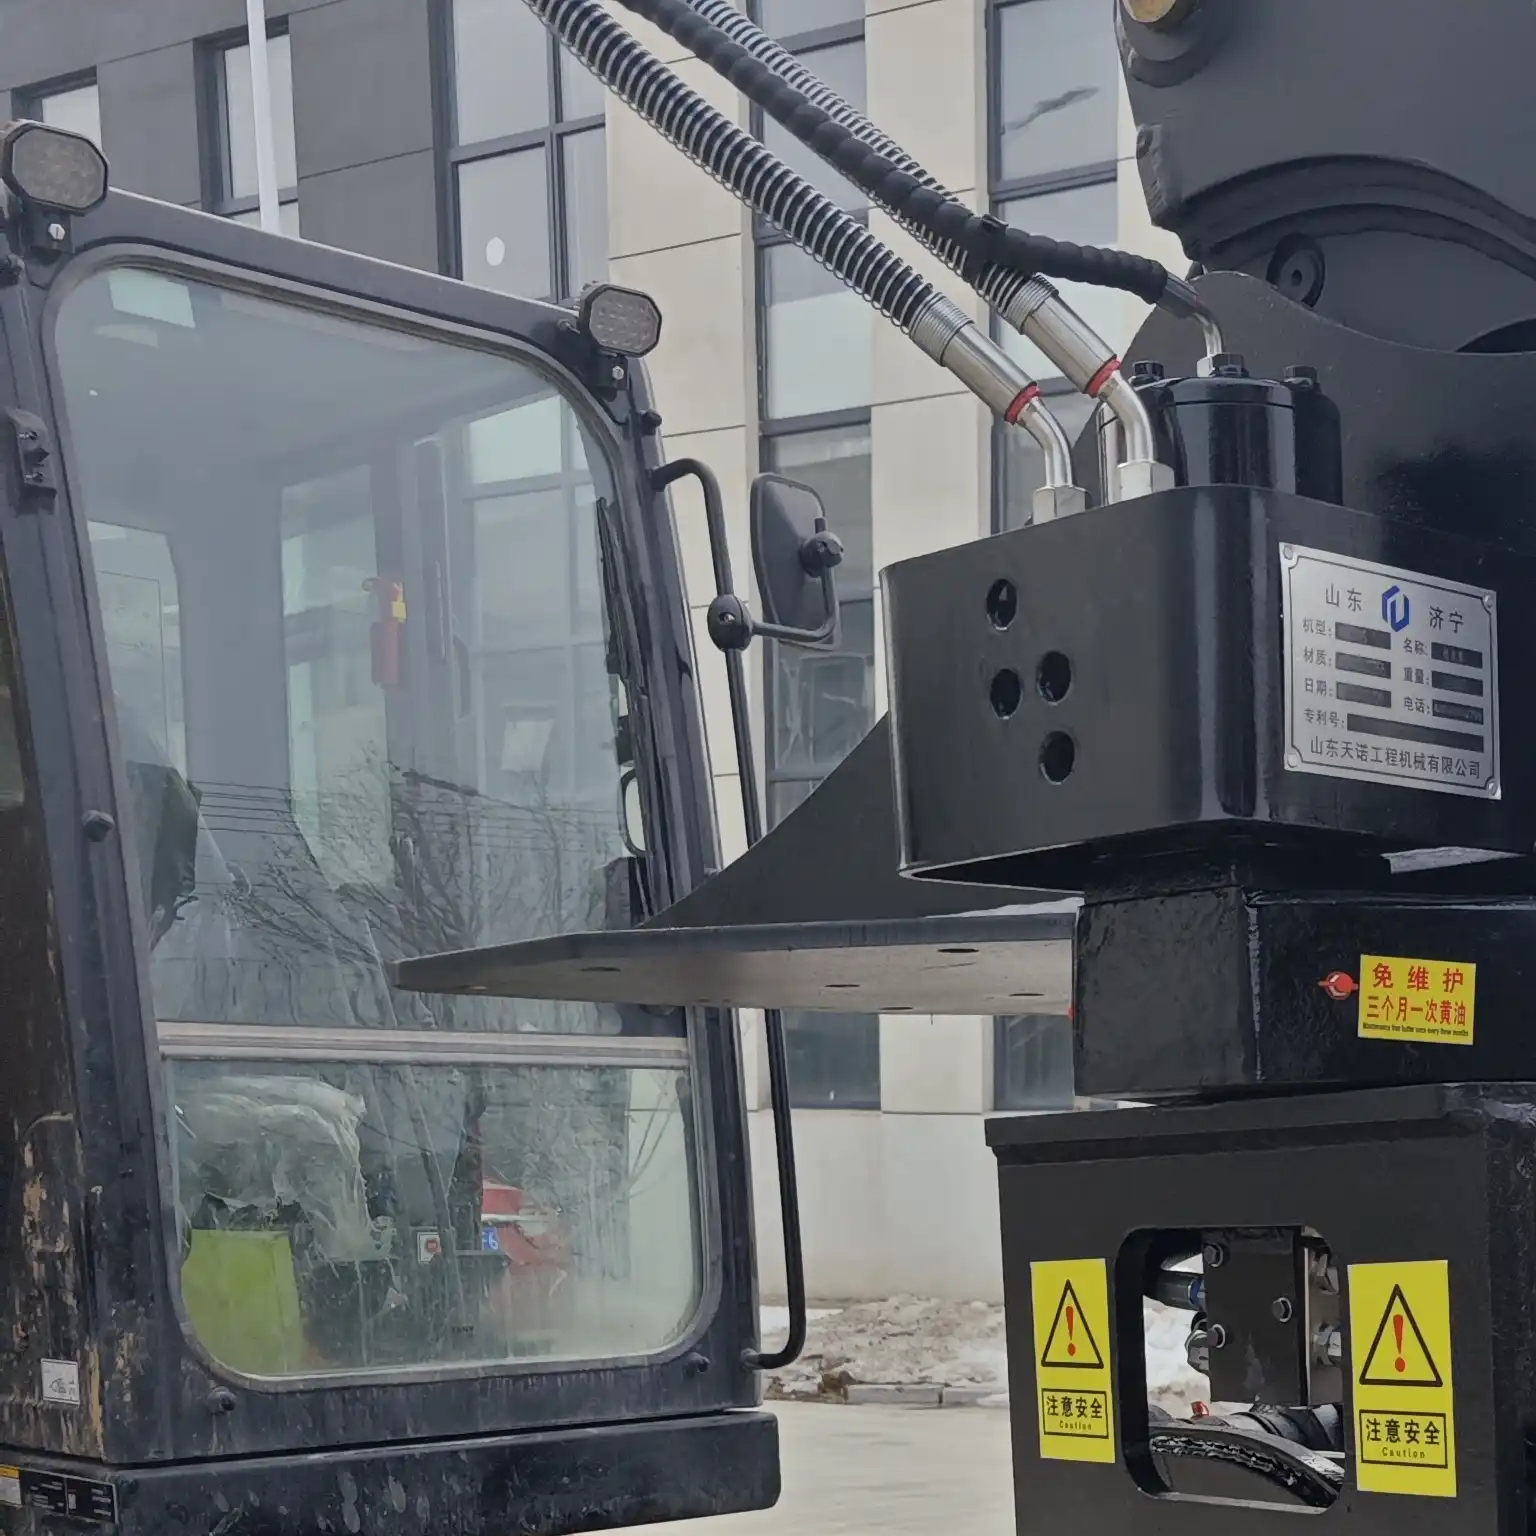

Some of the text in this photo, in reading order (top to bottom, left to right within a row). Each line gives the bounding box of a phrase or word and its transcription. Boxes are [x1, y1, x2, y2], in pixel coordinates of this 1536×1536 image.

[1325, 583, 1464, 633] 山东 济宁
[1310, 736, 1481, 779] 山东天诺工程机械有限公司
[1372, 962, 1464, 993] 免维护
[1367, 995, 1466, 1026] 三个月一次黄油
[1046, 1395, 1103, 1419] 注意安全
[1059, 1419, 1092, 1431] Caution
[1365, 1418, 1440, 1446] 注意安全
[1381, 1446, 1426, 1459] Caution
